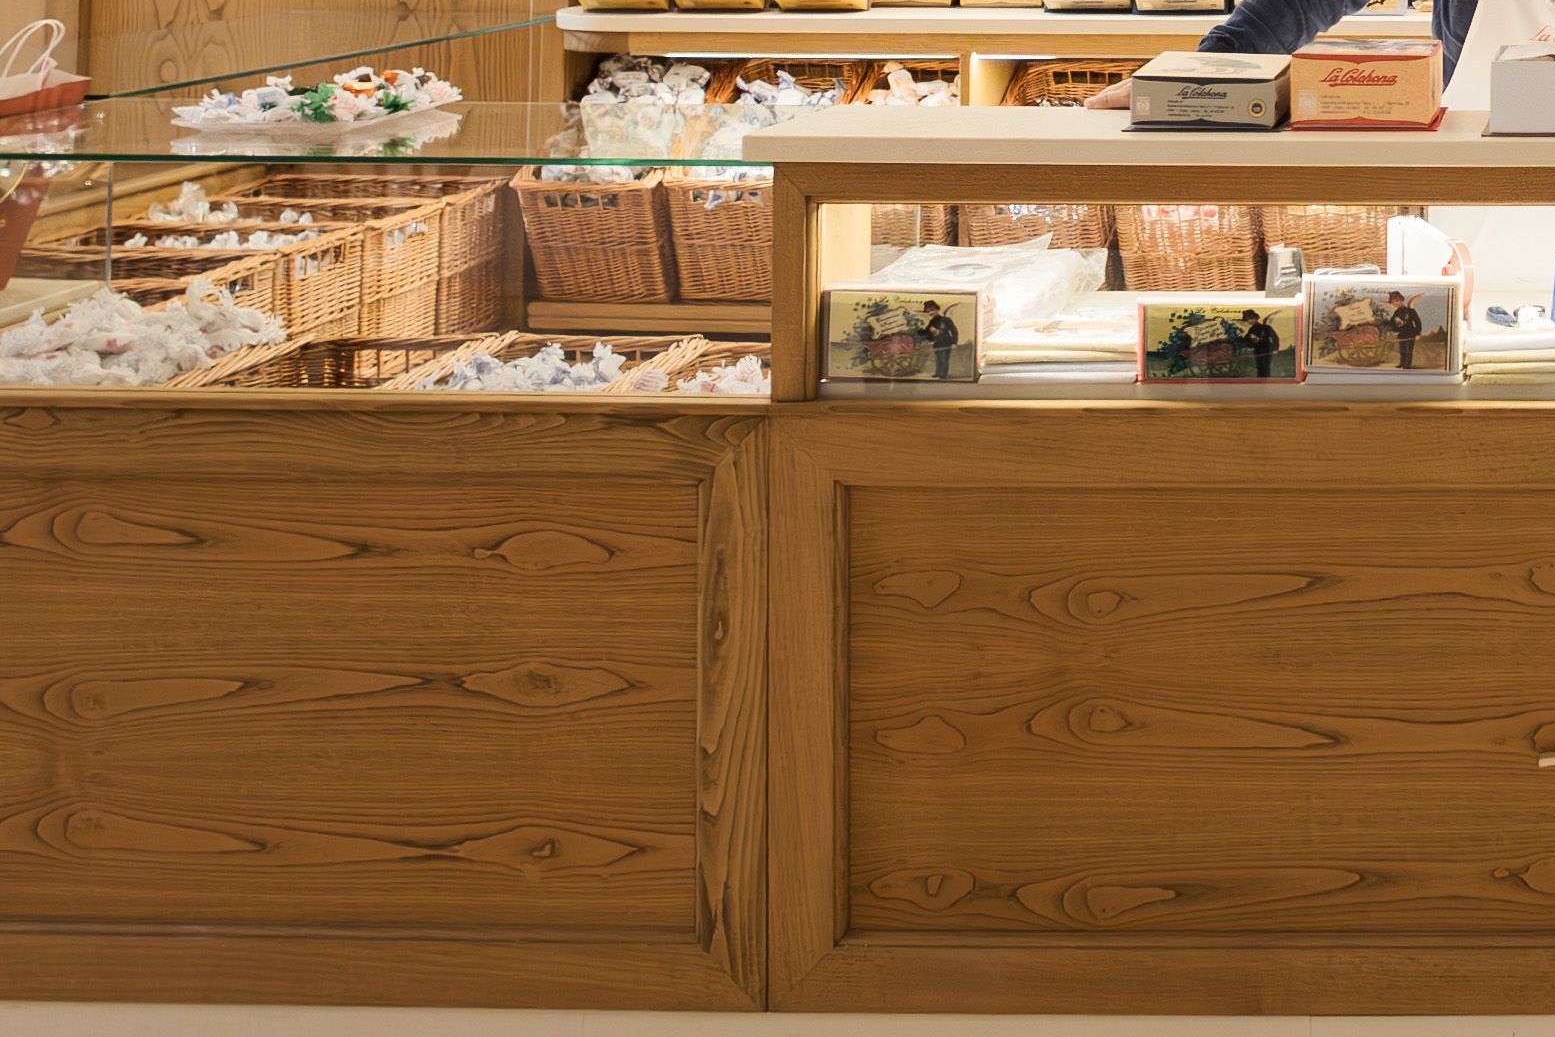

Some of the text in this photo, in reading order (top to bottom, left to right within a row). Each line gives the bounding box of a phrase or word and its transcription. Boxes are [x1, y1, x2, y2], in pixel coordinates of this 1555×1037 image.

[1529, 25, 1551, 42] La
[1319, 68, 1398, 85] La Colchona
